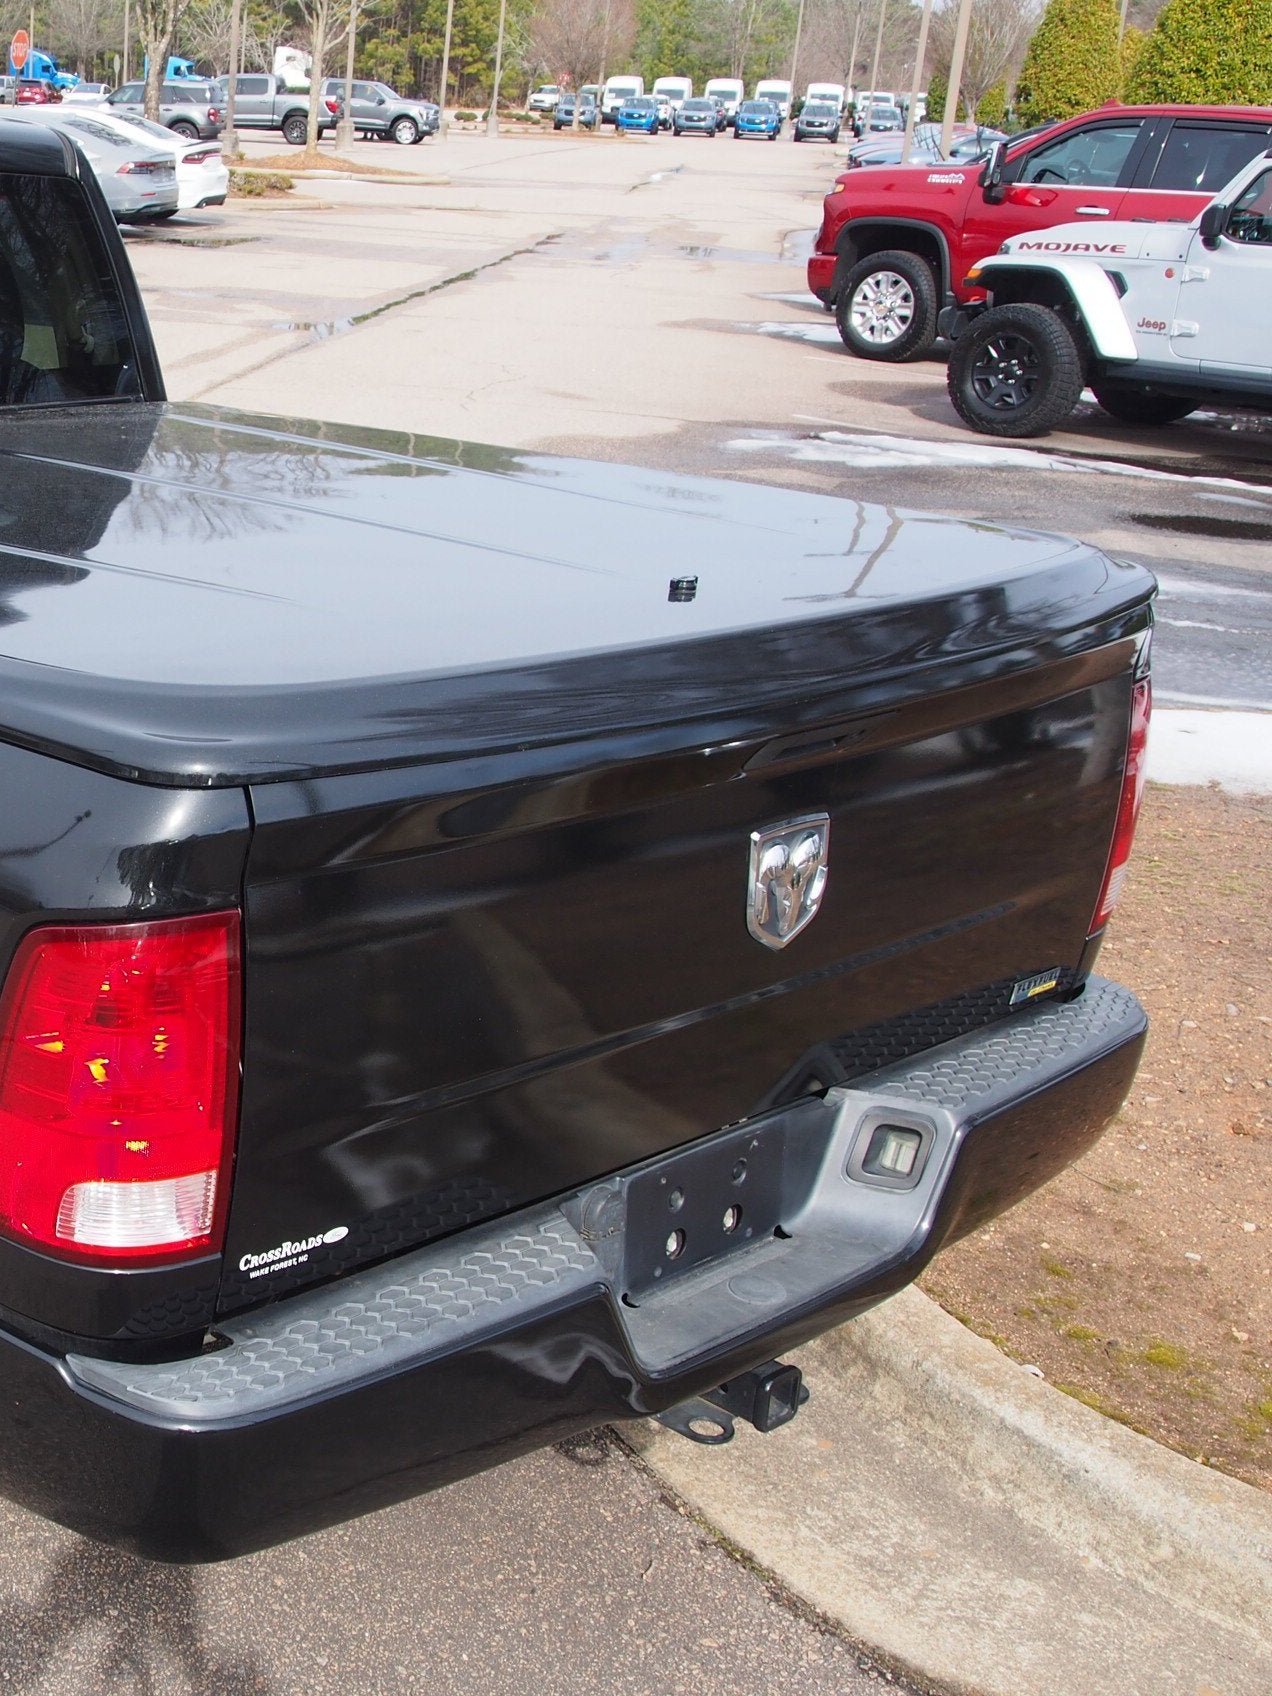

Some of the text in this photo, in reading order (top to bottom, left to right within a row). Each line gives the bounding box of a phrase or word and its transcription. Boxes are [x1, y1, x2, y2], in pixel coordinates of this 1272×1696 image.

[13, 42, 28, 57] STOP
[1018, 242, 1127, 253] MOJAVE
[1137, 317, 1166, 331] Jeep
[249, 1266, 269, 1279] WAKE
[298, 1254, 309, 1264] NC
